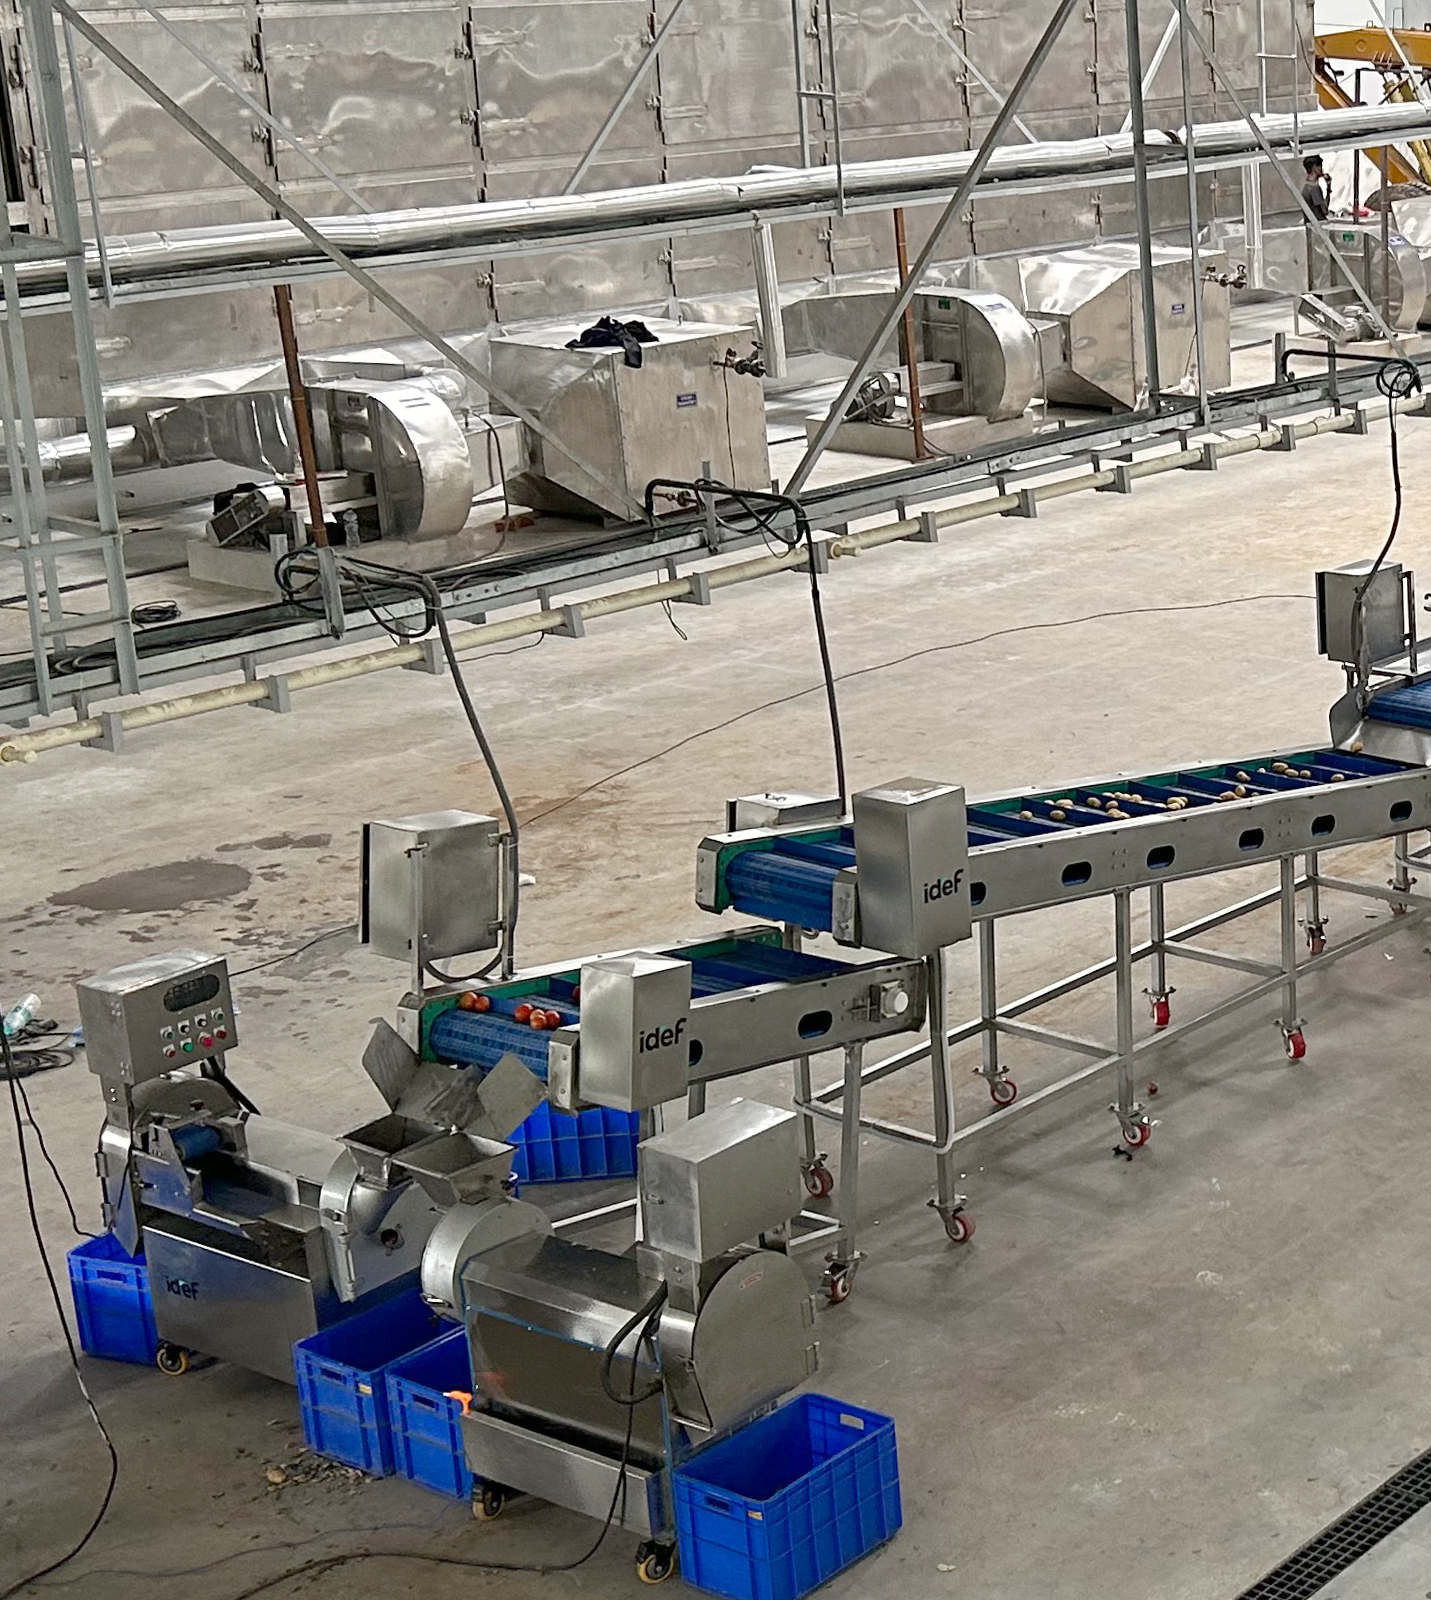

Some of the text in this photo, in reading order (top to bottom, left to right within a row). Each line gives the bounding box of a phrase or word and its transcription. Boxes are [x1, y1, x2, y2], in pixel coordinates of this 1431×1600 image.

[923, 868, 964, 904] idef
[639, 1017, 687, 1053] idef
[165, 1275, 199, 1300] idef
